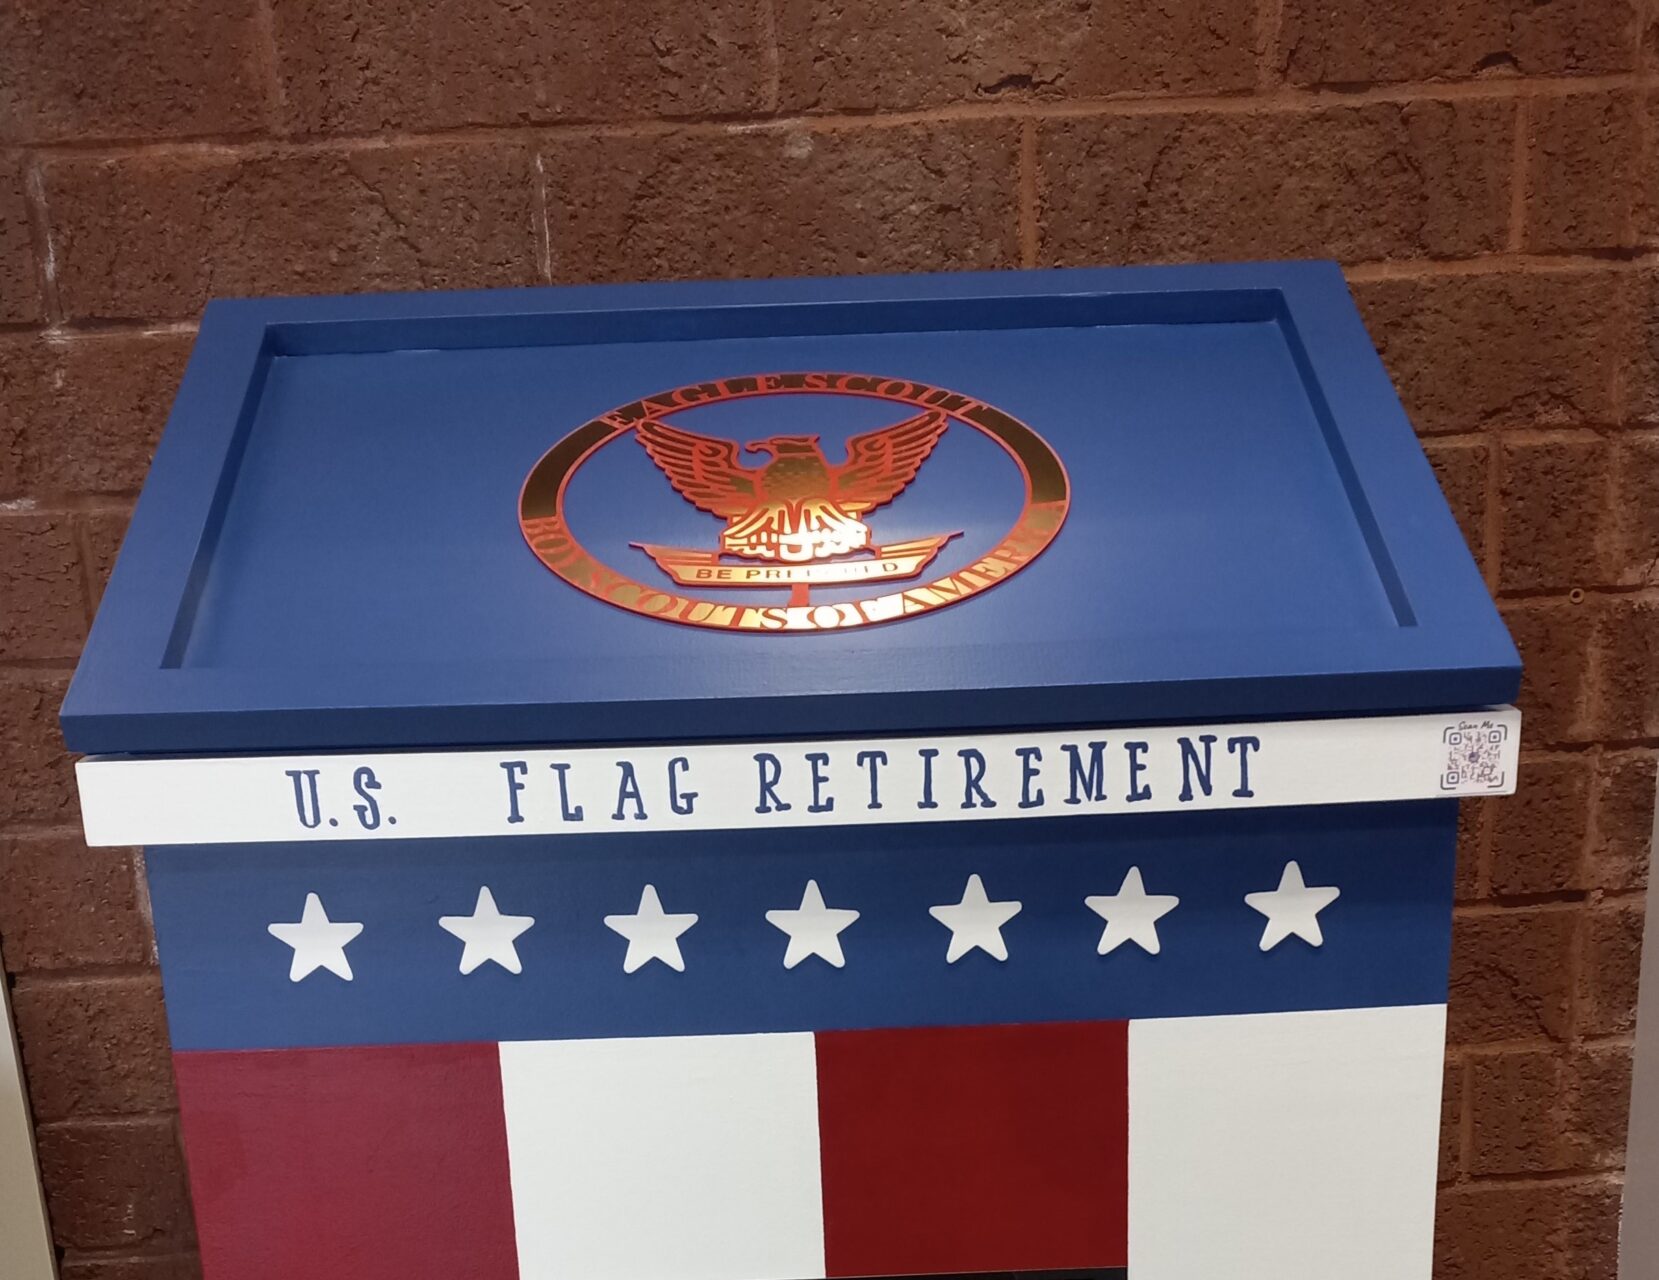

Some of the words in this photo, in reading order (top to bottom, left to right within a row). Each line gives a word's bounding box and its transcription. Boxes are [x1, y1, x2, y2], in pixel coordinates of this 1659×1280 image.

[599, 374, 785, 429] EAGLE
[802, 373, 988, 417] SCOUT
[695, 568, 733, 580] BE
[284, 765, 397, 831] U.S.
[500, 756, 699, 823] FLAG
[753, 734, 1261, 814] RETIREMENT
